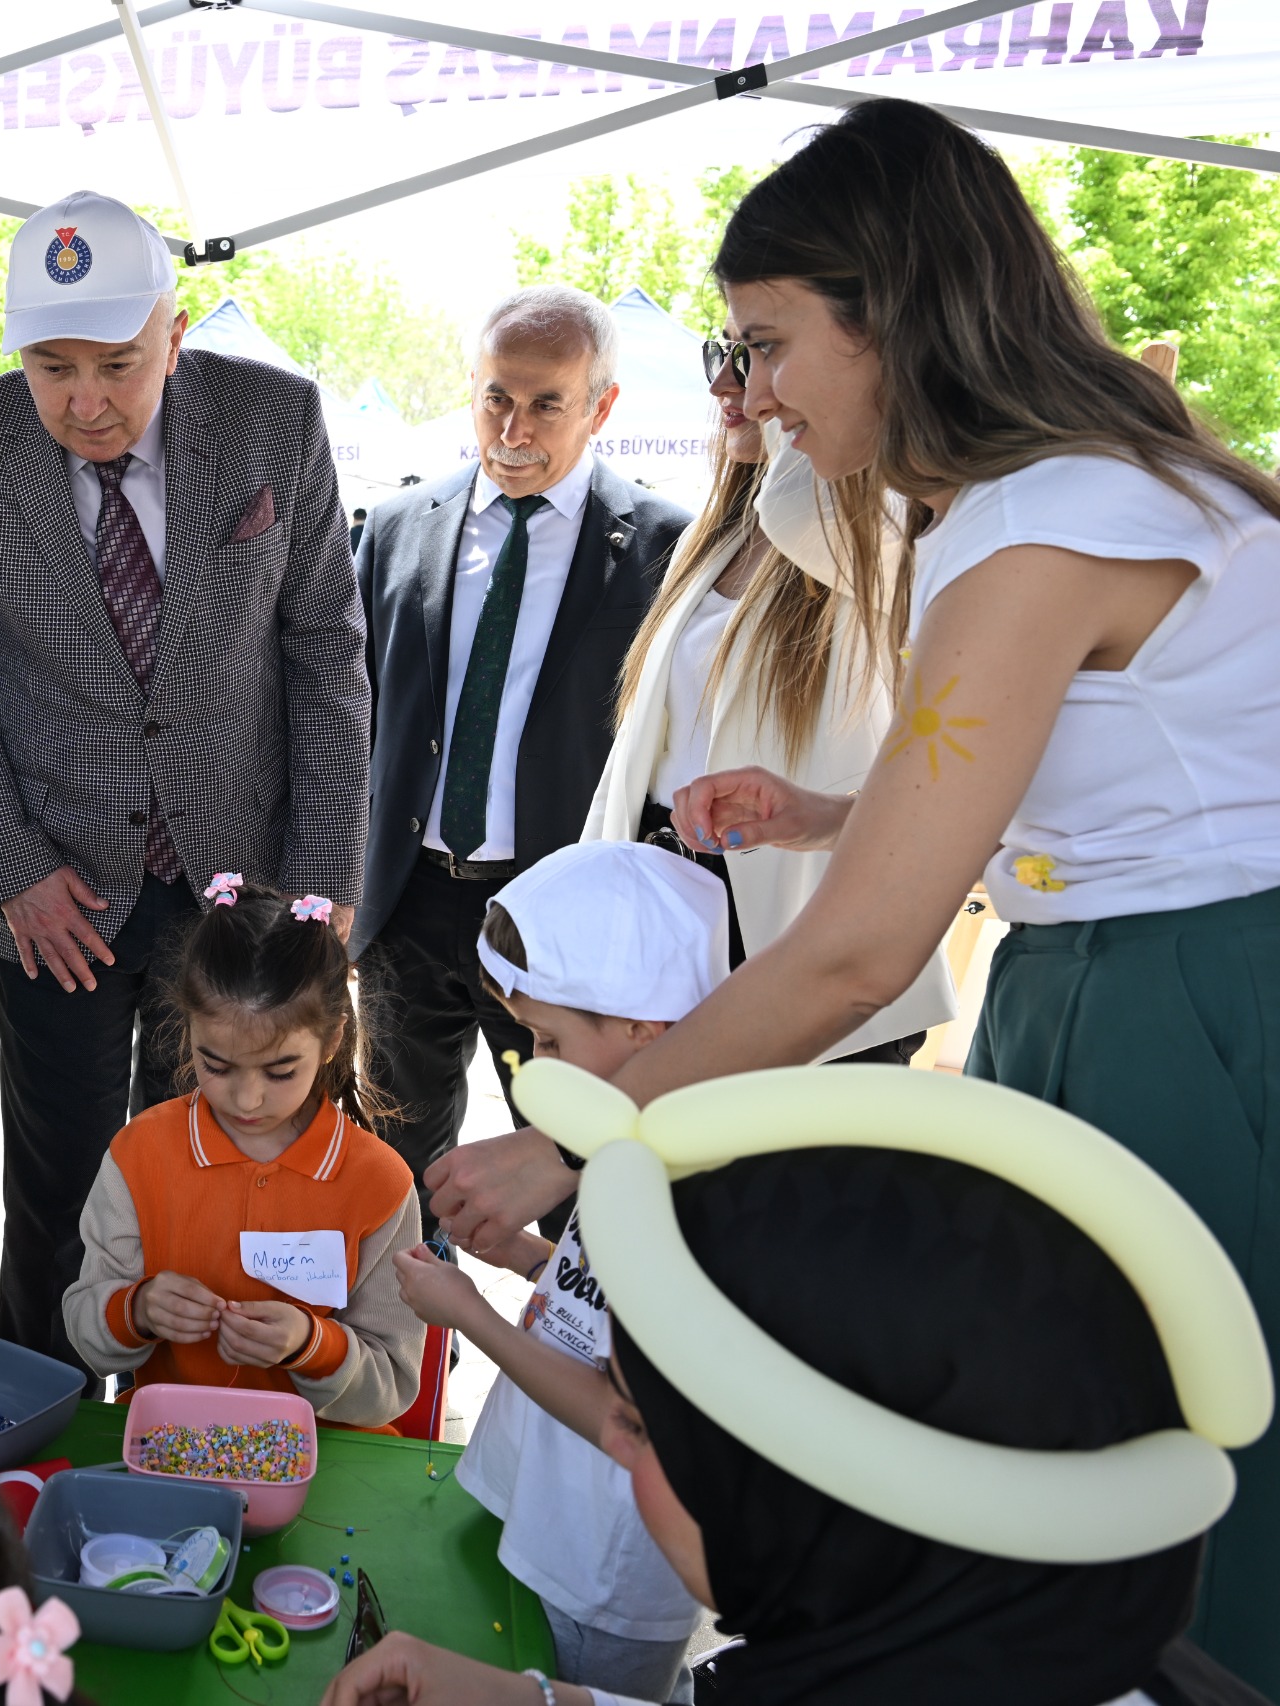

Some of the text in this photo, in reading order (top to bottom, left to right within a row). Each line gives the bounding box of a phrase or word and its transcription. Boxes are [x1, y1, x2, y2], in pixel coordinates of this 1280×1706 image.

[59, 255, 76, 263] 1992
[253, 1250, 315, 1274] Meryem
[555, 1306, 584, 1330] BULLS.
[557, 1327, 595, 1355] KNICKS
